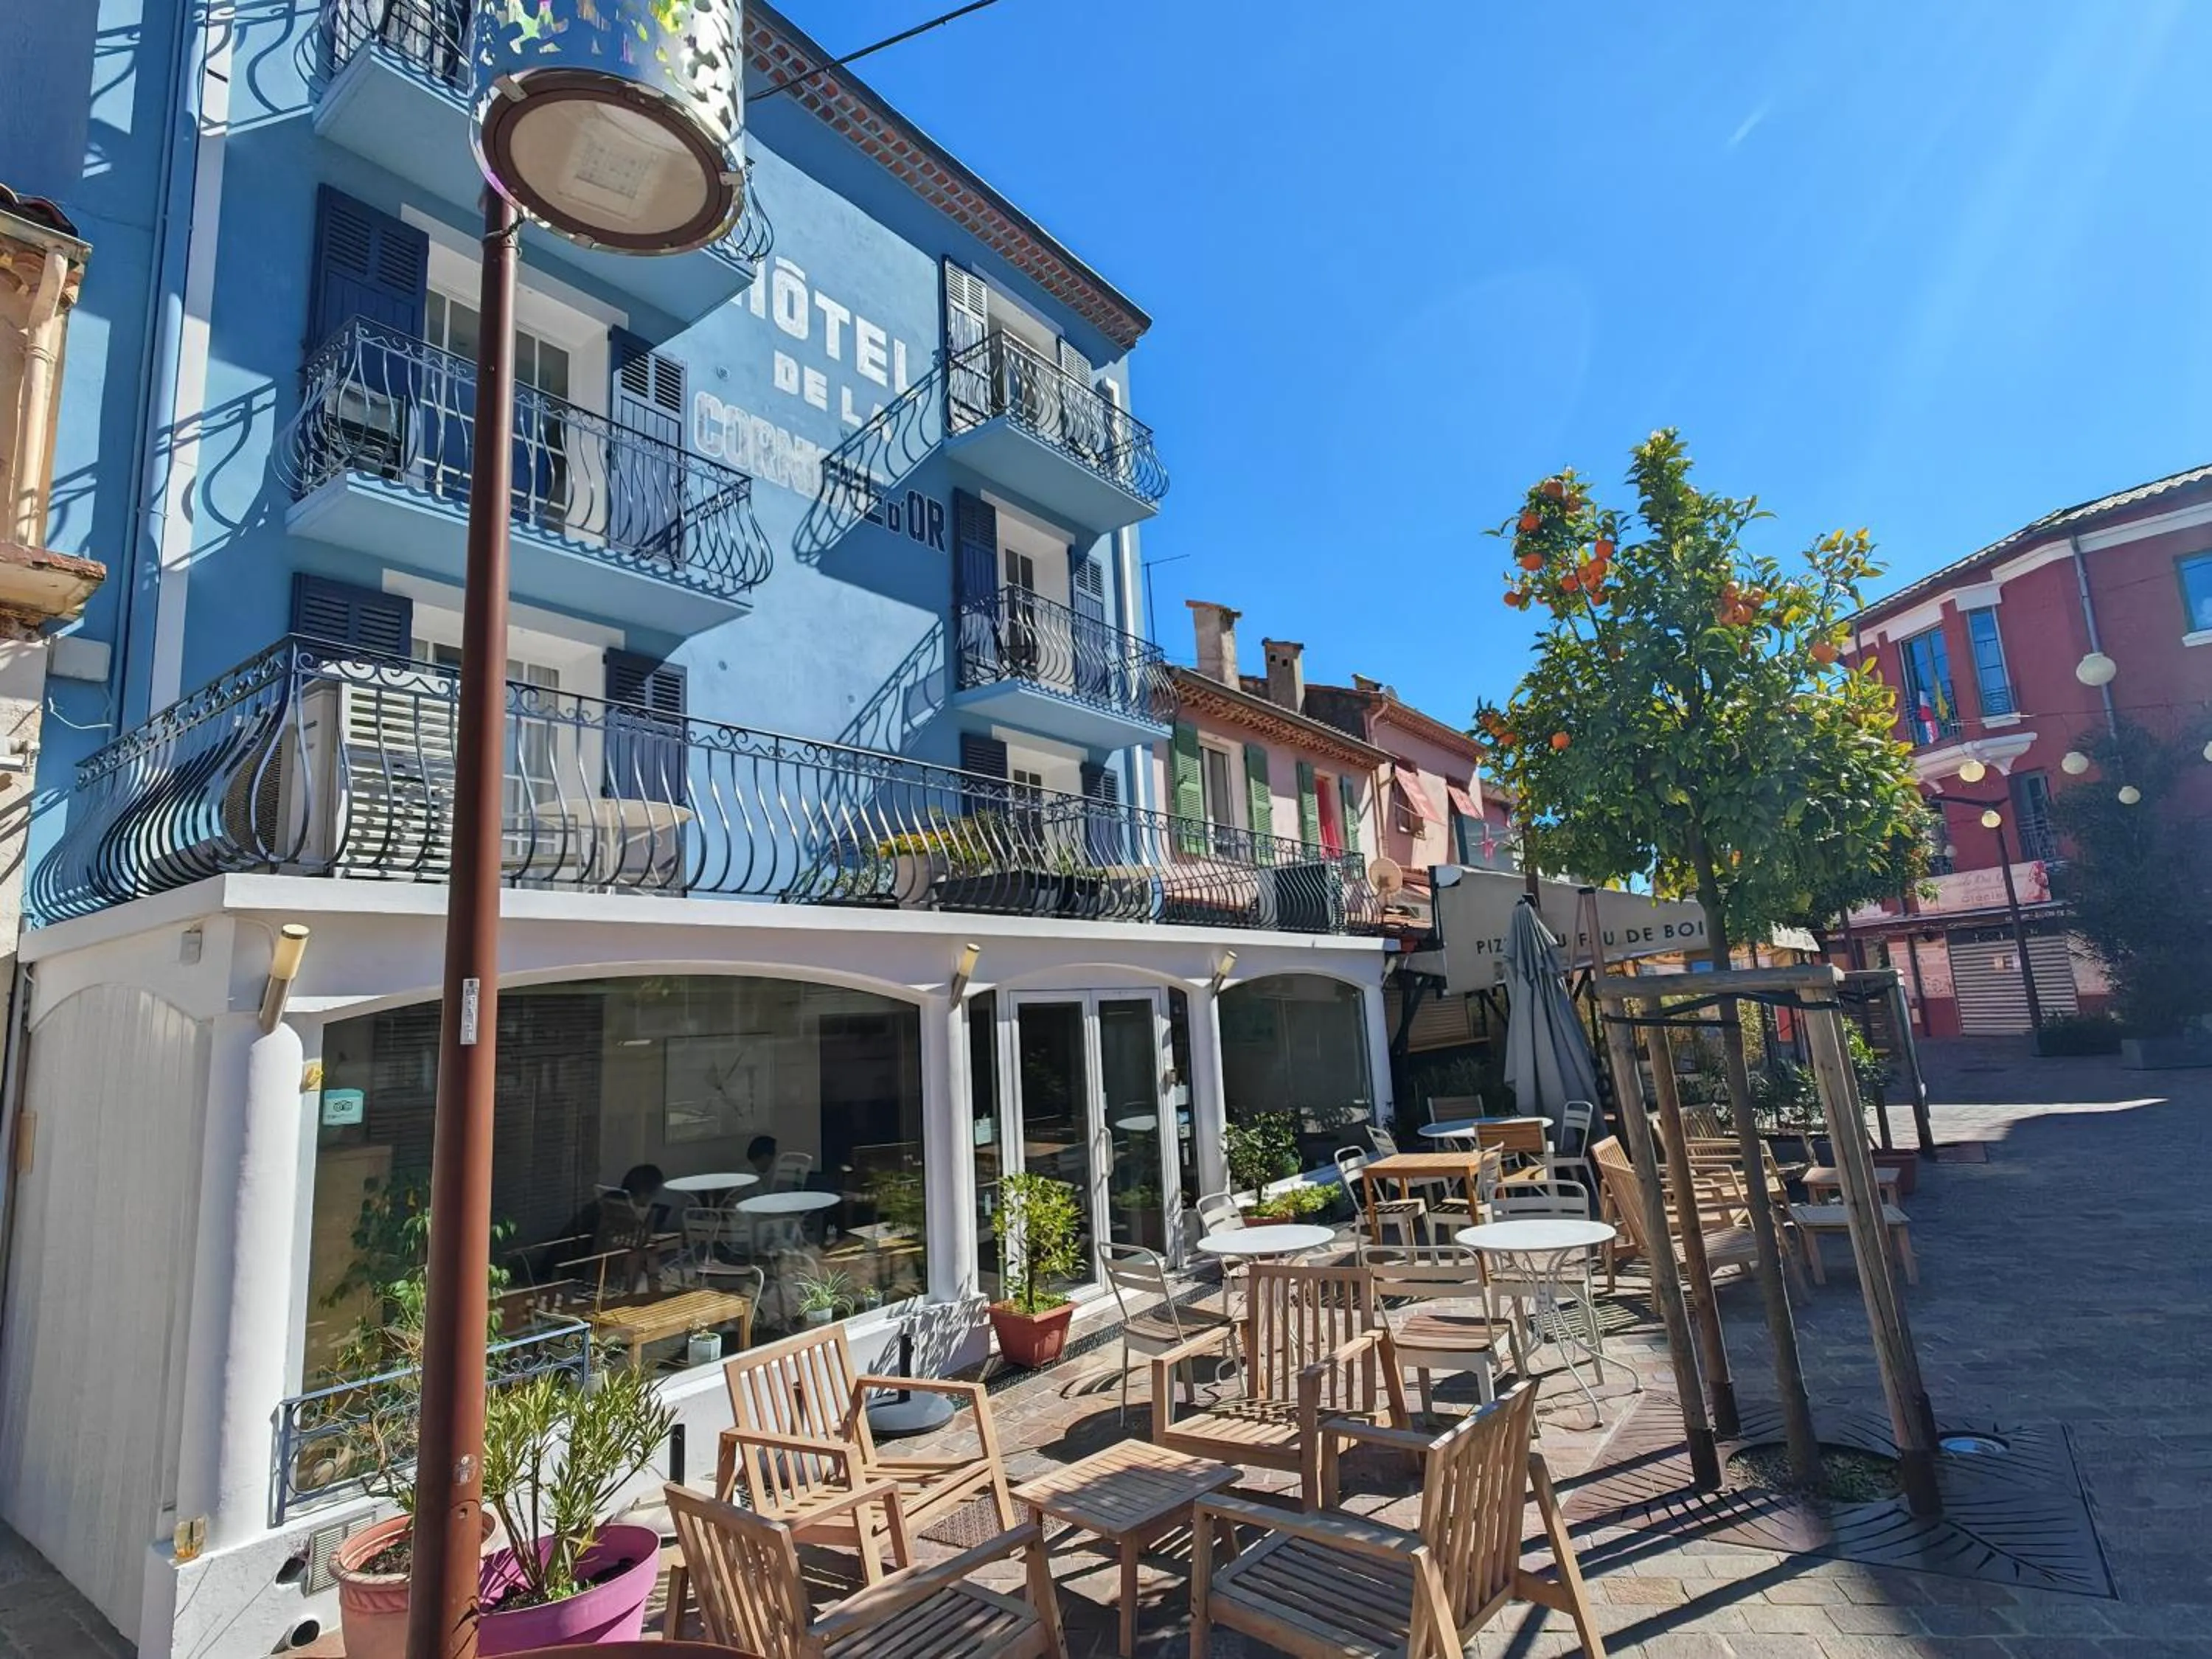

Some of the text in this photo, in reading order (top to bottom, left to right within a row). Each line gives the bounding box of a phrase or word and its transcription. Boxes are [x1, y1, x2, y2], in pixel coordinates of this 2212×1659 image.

[774, 349, 892, 442] DE LA
[1579, 931, 1614, 947] FU
[1627, 927, 1653, 944] DE
[1664, 920, 1704, 939] BOI
